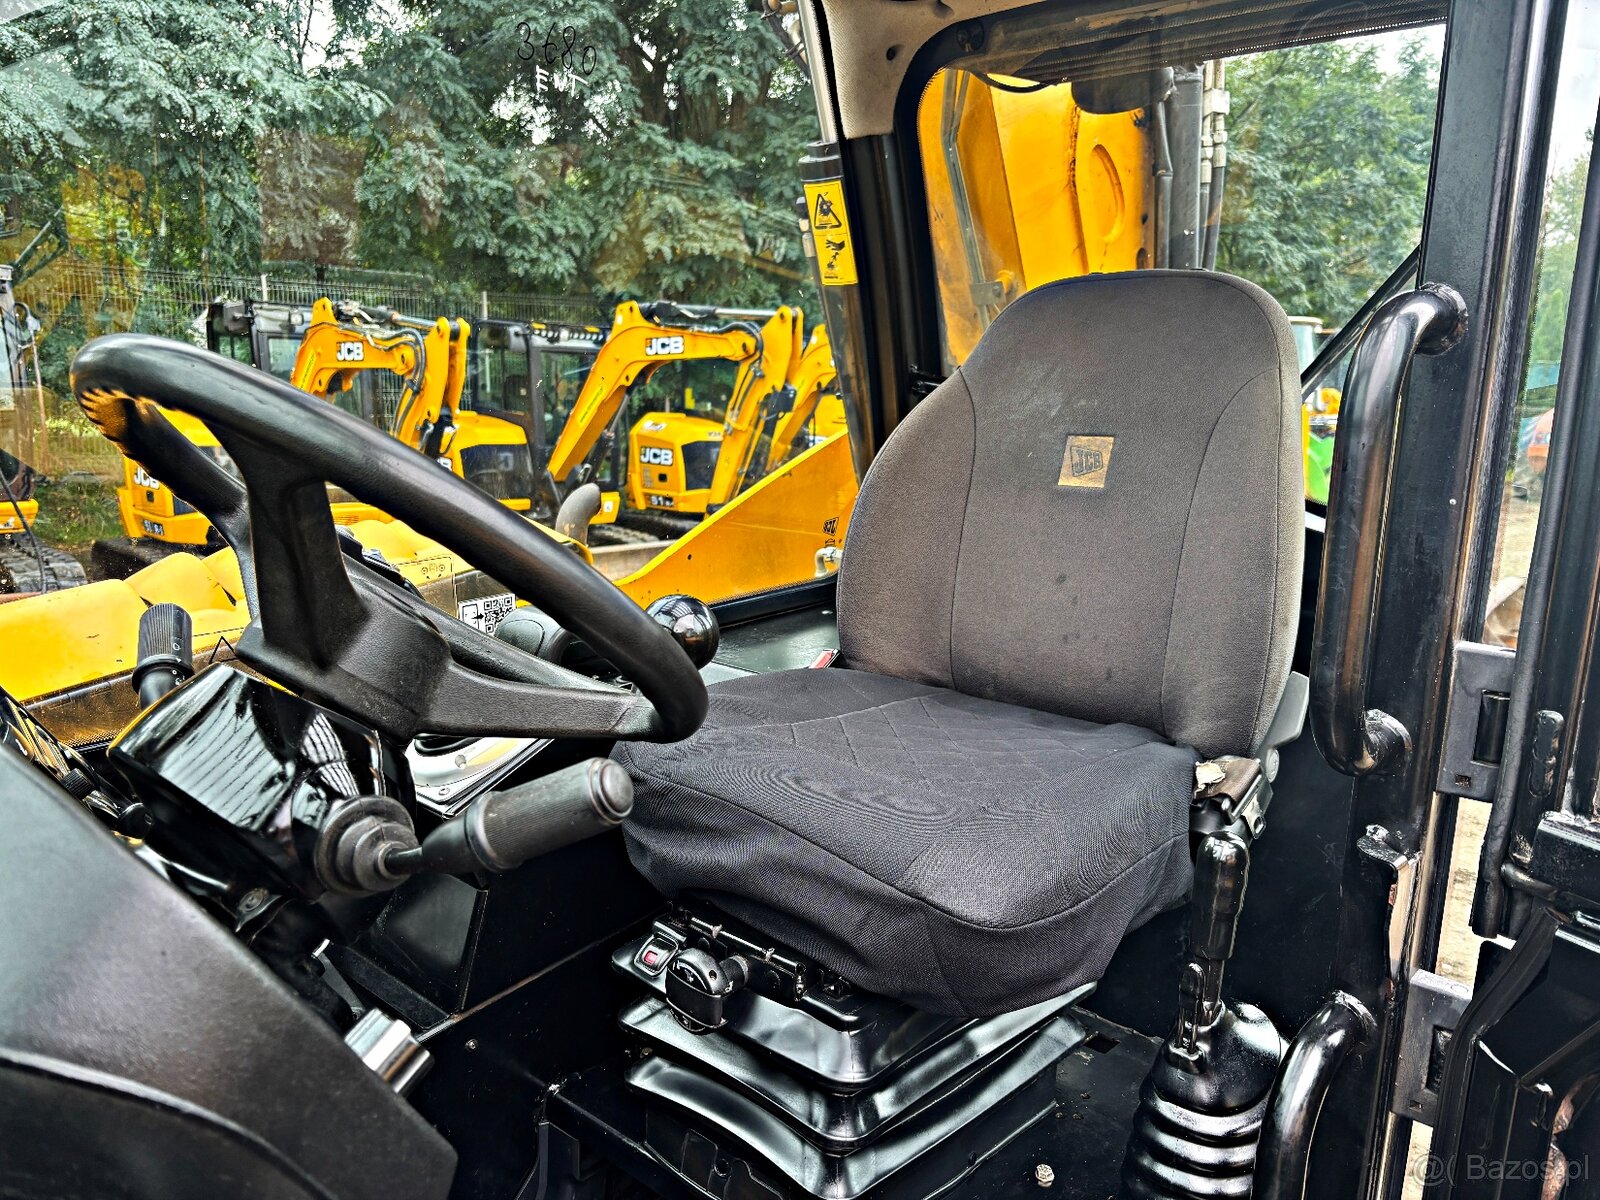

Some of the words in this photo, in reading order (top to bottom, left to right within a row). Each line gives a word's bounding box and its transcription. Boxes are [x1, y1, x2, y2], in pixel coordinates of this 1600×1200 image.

[516, 22, 597, 75] 3680
[336, 341, 364, 361] JCB
[645, 336, 685, 355] JCB
[640, 446, 673, 466] JCB
[1071, 447, 1103, 476] JCB
